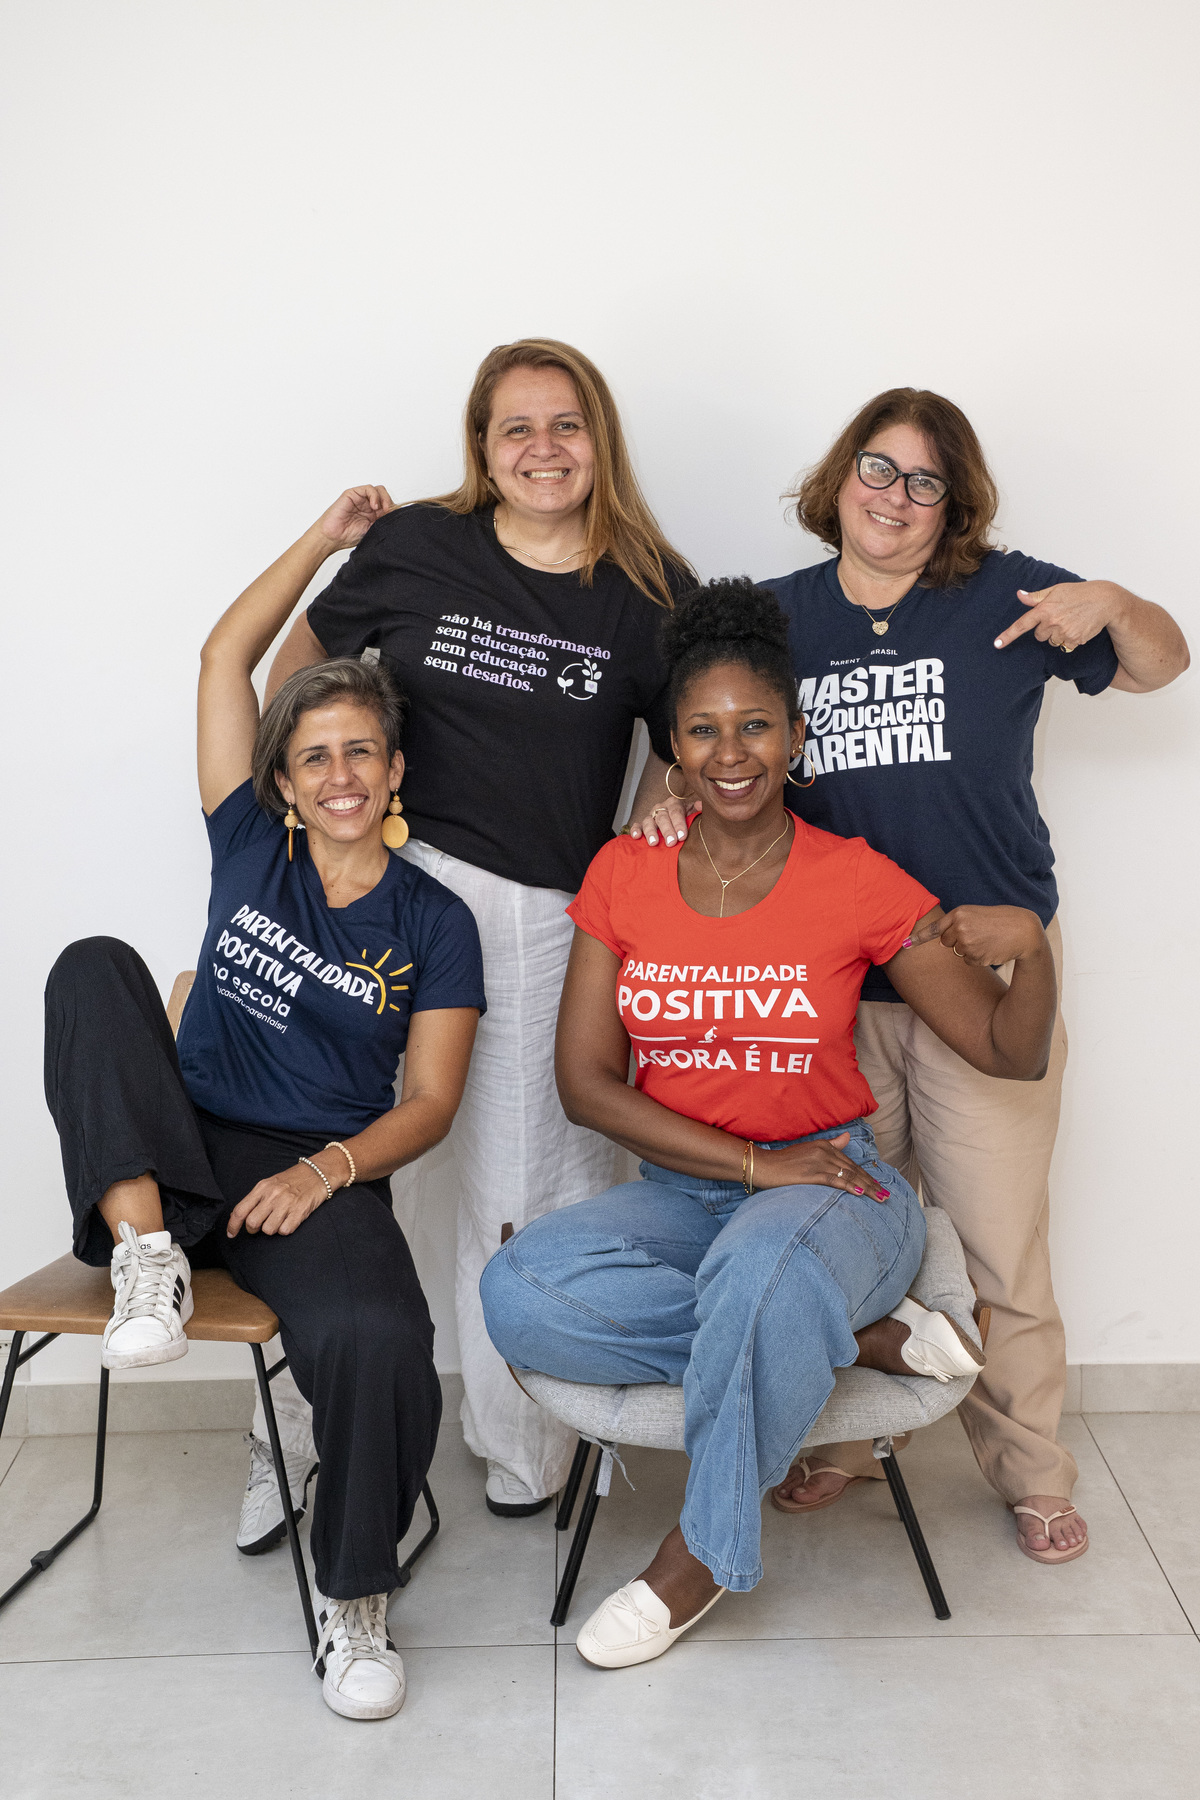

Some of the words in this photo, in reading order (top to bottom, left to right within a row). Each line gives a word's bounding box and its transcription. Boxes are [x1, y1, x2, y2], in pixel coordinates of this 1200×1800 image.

[435, 624, 467, 641] sem
[471, 633, 550, 662] educação.
[471, 615, 492, 632] há
[495, 623, 611, 660] transformação
[423, 655, 458, 673] sem
[462, 663, 534, 692] desafios.
[430, 640, 466, 657] nem
[469, 649, 548, 677] educação
[830, 657, 861, 666] PARENT
[795, 658, 945, 711] MASTER
[788, 724, 951, 778] ARENTAL
[216, 929, 304, 998] POSITIVA
[230, 904, 379, 1005] PARENTALIDADE
[624, 959, 808, 983] PARENTALIDADE
[232, 976, 291, 1018] escola
[618, 984, 819, 1021] POSITIVA
[638, 1048, 738, 1070] AGORA
[745, 1043, 761, 1072] É
[770, 1051, 813, 1074] LEI
